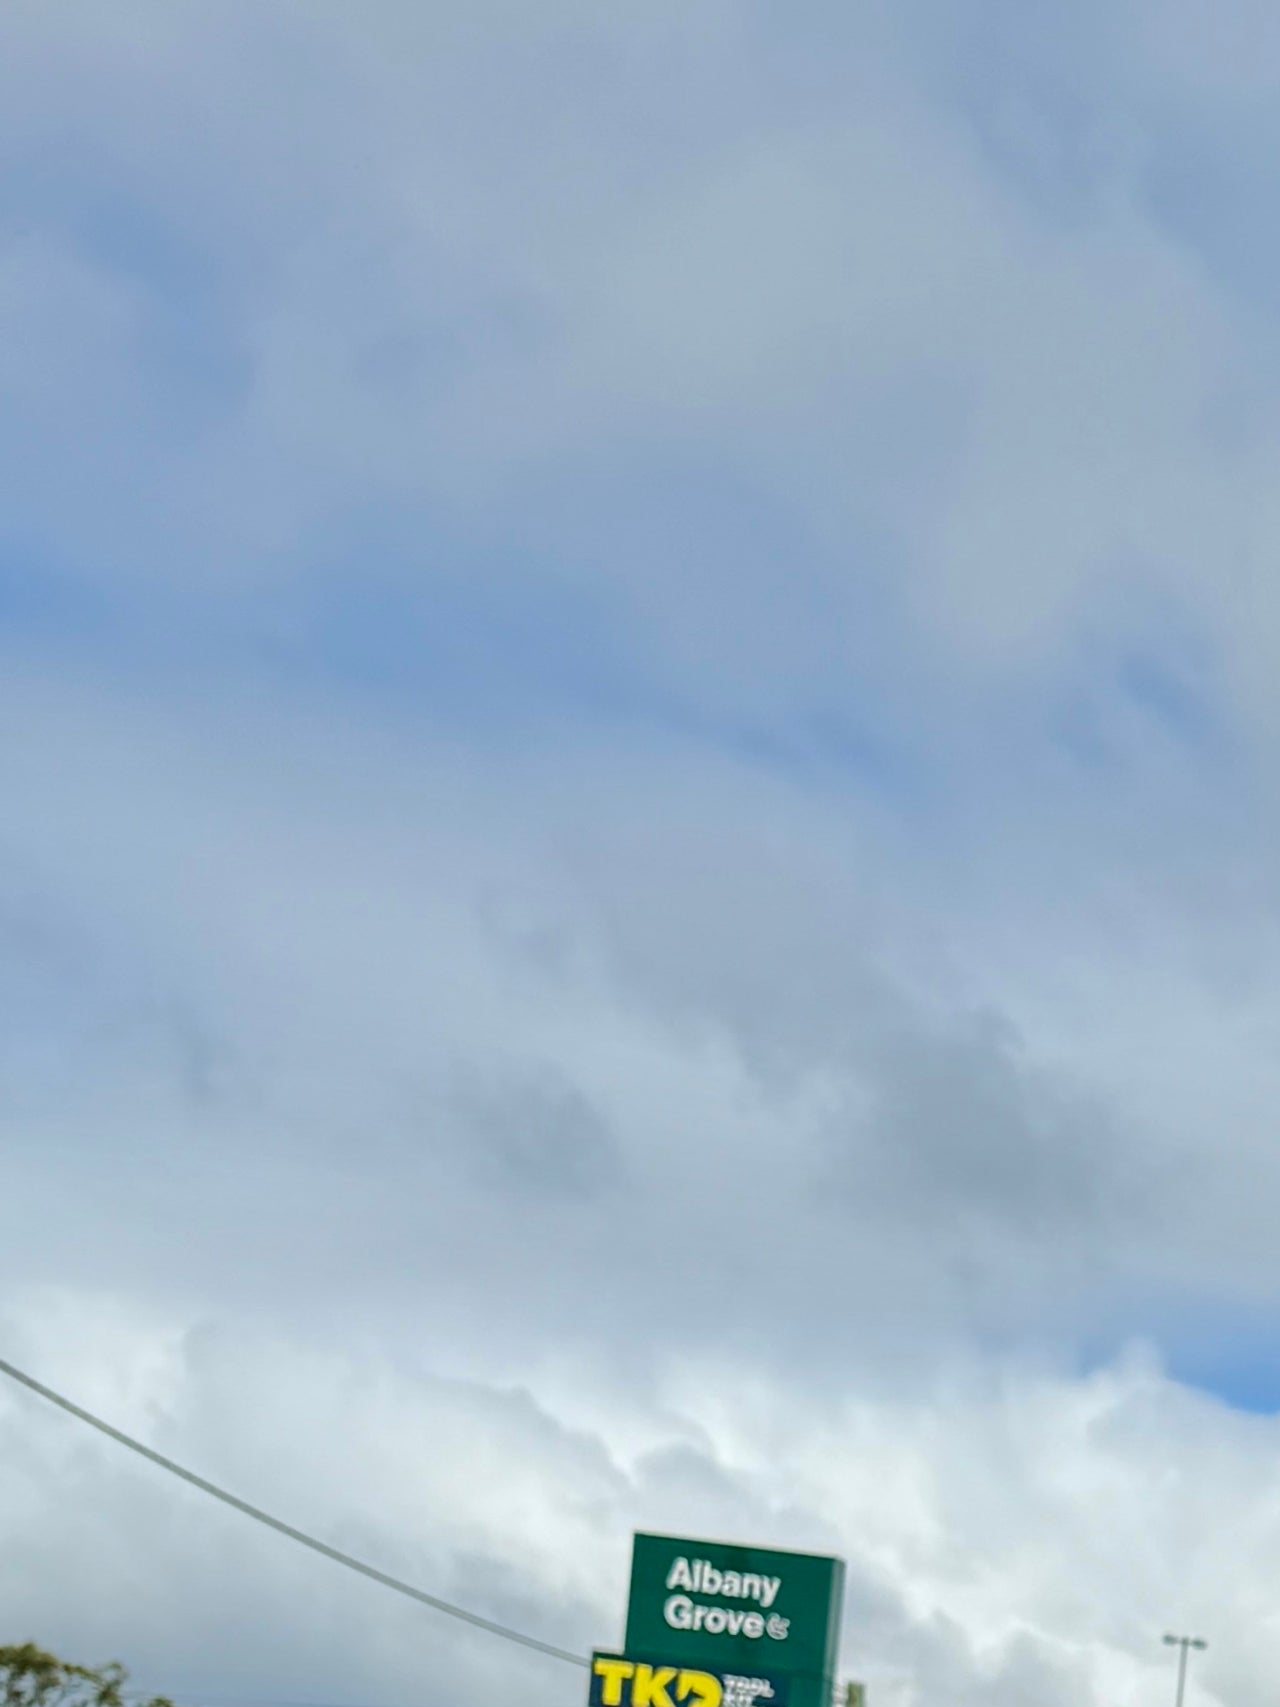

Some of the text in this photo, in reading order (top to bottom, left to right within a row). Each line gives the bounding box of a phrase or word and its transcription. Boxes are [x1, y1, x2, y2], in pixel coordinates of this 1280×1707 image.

[666, 1556, 781, 1608] Albany
[664, 1594, 766, 1639] Grove
[722, 1673, 775, 1698] TOOL
